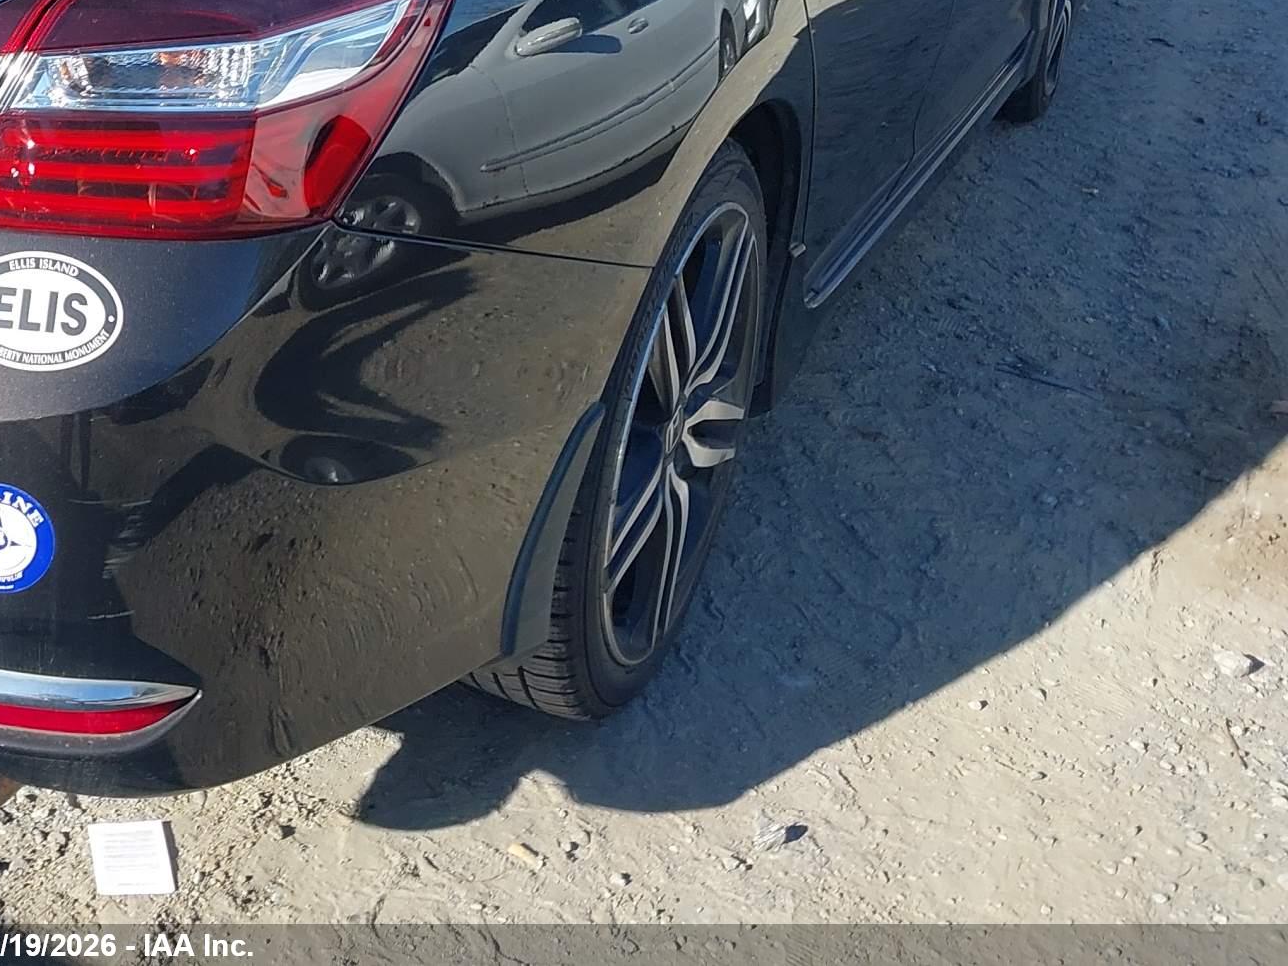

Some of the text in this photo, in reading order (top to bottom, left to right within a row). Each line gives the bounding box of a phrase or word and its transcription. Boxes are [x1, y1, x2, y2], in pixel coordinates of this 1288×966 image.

[8, 257, 80, 278] ELLIS ISLAND
[22, 353, 63, 365] NATIONAL
[64, 328, 111, 362] MONUMENT
